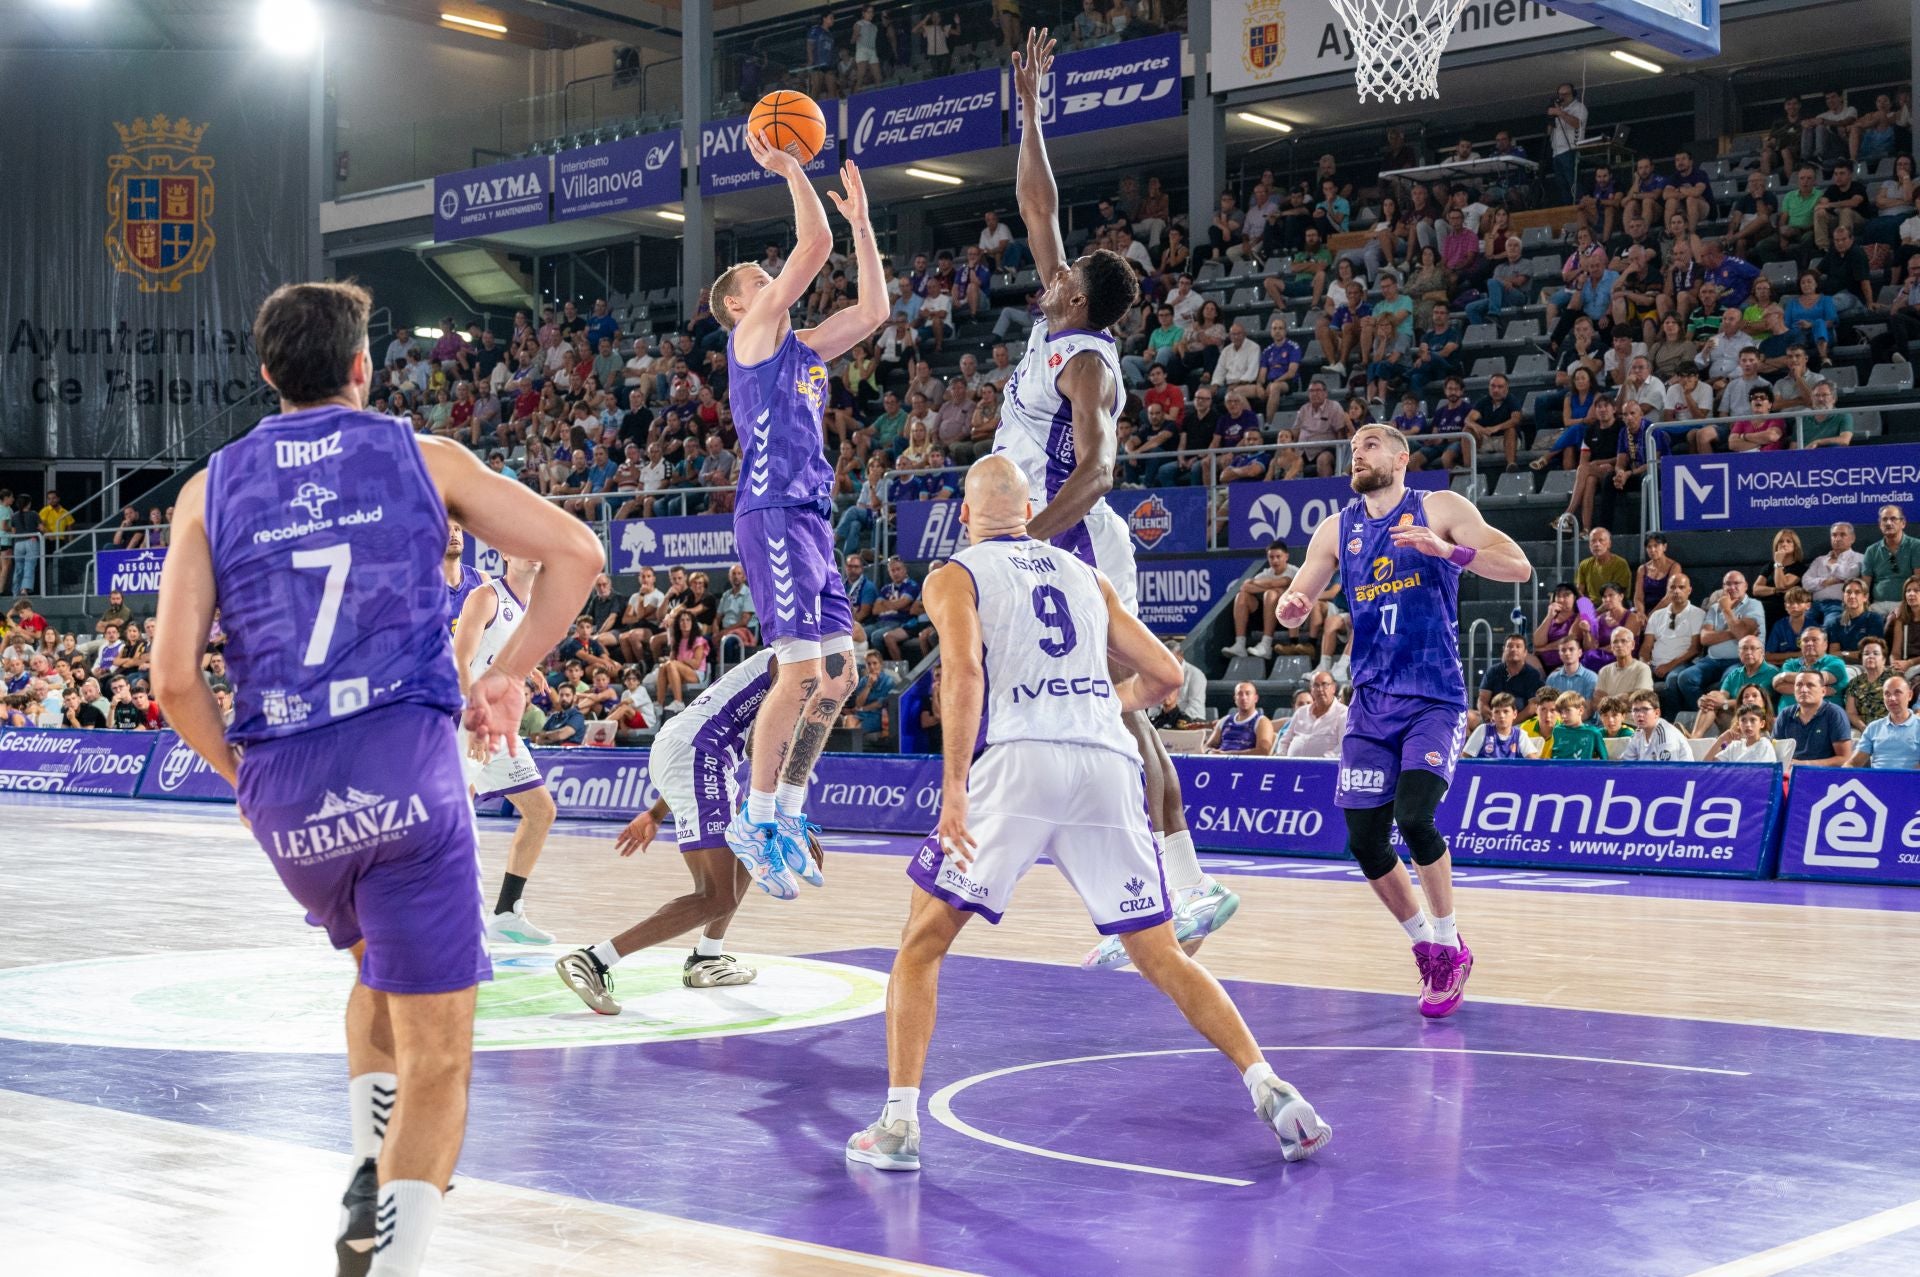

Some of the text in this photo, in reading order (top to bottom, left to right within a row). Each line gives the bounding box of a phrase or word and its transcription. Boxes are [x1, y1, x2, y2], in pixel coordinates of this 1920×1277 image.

[1065, 57, 1170, 86] Transportes
[882, 91, 997, 125] NEUMÁTICOS
[1060, 77, 1175, 115] BUJ
[874, 117, 964, 147] PALENCIA
[560, 156, 610, 174] Interiorismo
[711, 170, 760, 187] Transporte
[801, 159, 825, 172] culos
[463, 172, 542, 206] VAYMA
[562, 169, 643, 200] Villanova
[460, 212, 487, 225] LIMPIEZA
[495, 202, 544, 218] MANTENIMIENTO
[32, 371, 82, 405] de
[1750, 490, 1914, 511] Implantología Dental Inmediata
[253, 505, 383, 544] recoletas salud
[1131, 517, 1169, 530] PALENCIA
[662, 530, 738, 558] TECNICAMP
[118, 562, 165, 572] DESGUA
[1136, 569, 1211, 602] VENIDOS
[1355, 583, 1376, 592] super
[1356, 573, 1422, 602] agropal
[292, 543, 352, 667] 7
[1138, 605, 1198, 614] NTIMIENTO
[1142, 614, 1187, 623] ENTINO.
[1380, 603, 1398, 635] 17
[1032, 583, 1077, 658] 9
[1012, 678, 1109, 703] IVECO
[0, 731, 81, 754] Gestinver.
[72, 754, 146, 775] MODOS
[1195, 771, 1304, 792] OTEL
[1341, 768, 1385, 791] gaza
[820, 781, 944, 815] ramos óp
[1461, 776, 1742, 839] lambda
[272, 793, 430, 860] LEBANZA
[707, 821, 726, 832] CBC
[1195, 805, 1323, 836] SANCHO
[1456, 831, 1734, 861] frigoríficas www.proylam.es
[1119, 896, 1156, 913] CRZA
